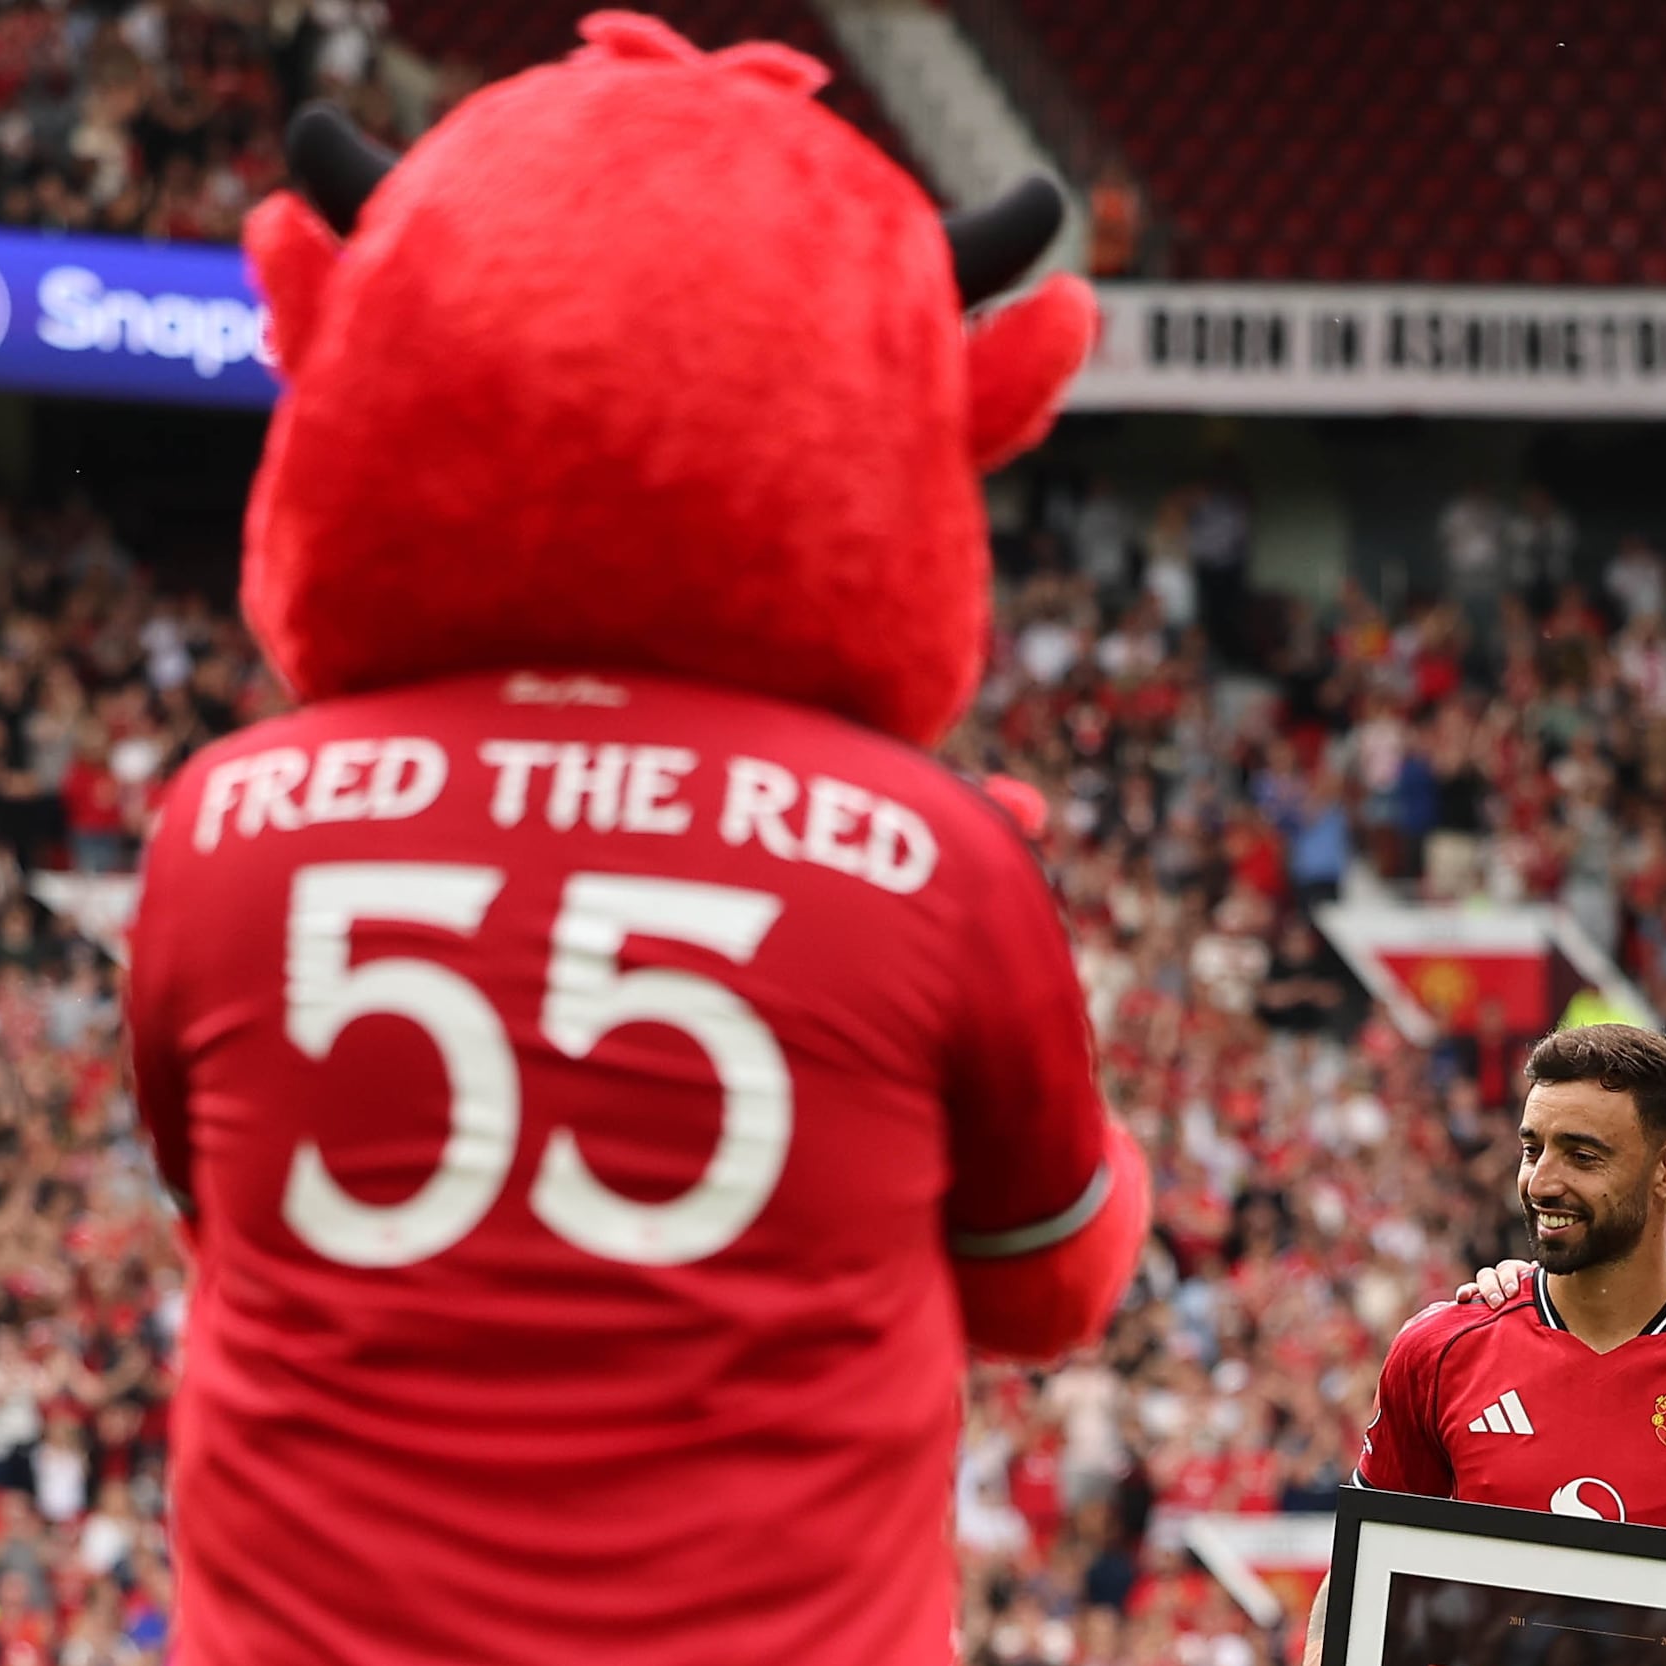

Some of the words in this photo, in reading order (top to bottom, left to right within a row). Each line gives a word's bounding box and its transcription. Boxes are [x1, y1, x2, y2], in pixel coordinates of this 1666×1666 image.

[36, 265, 284, 378] Snap
[1145, 308, 1290, 371] BORN
[1309, 310, 1361, 374] IN
[193, 737, 448, 853] FRED
[478, 740, 697, 834] THE
[719, 757, 939, 894] RED
[281, 860, 795, 1268] 55
[1509, 1616, 1526, 1627] 2011
